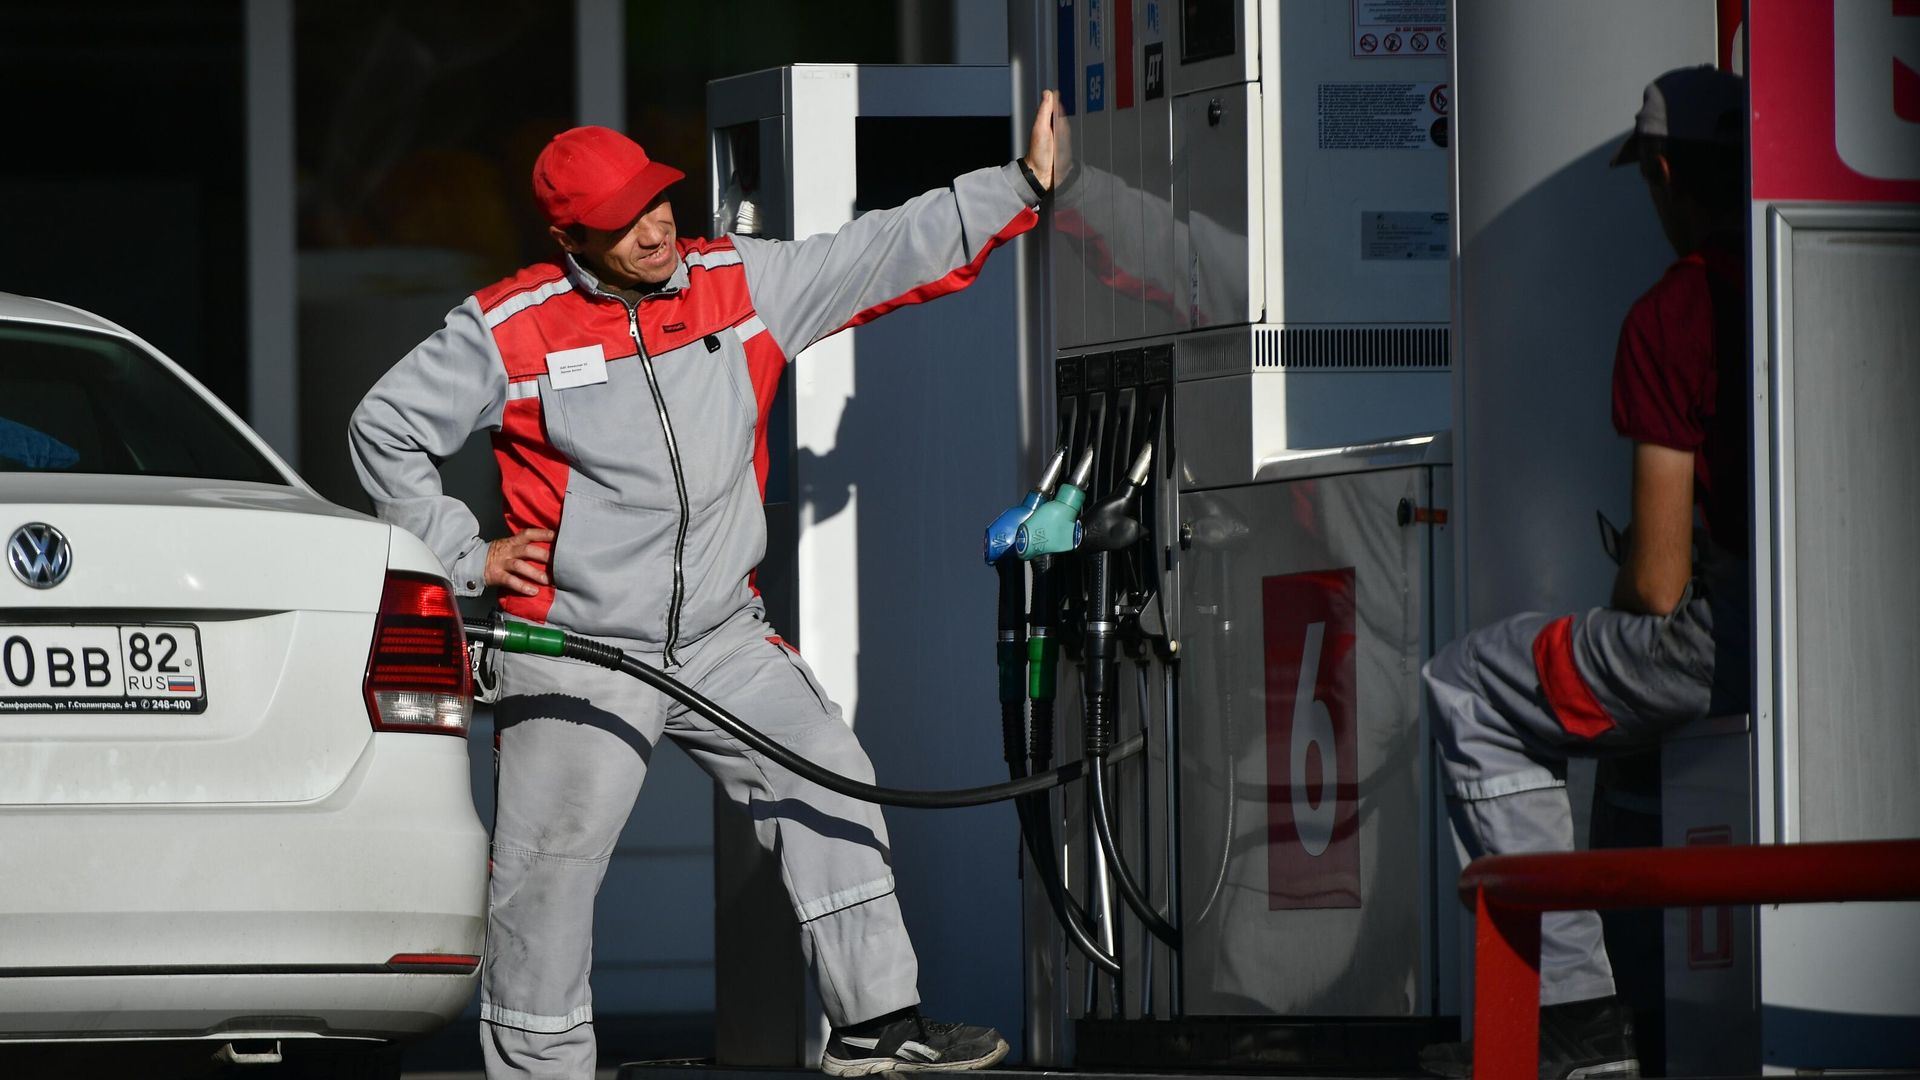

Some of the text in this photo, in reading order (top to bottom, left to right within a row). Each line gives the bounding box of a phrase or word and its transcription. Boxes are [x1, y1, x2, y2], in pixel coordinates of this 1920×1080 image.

[1089, 75, 1102, 101] 95
[129, 631, 180, 673] 82
[129, 676, 167, 691] RUS
[152, 699, 192, 710] 248-400
[1288, 621, 1338, 858] 6
